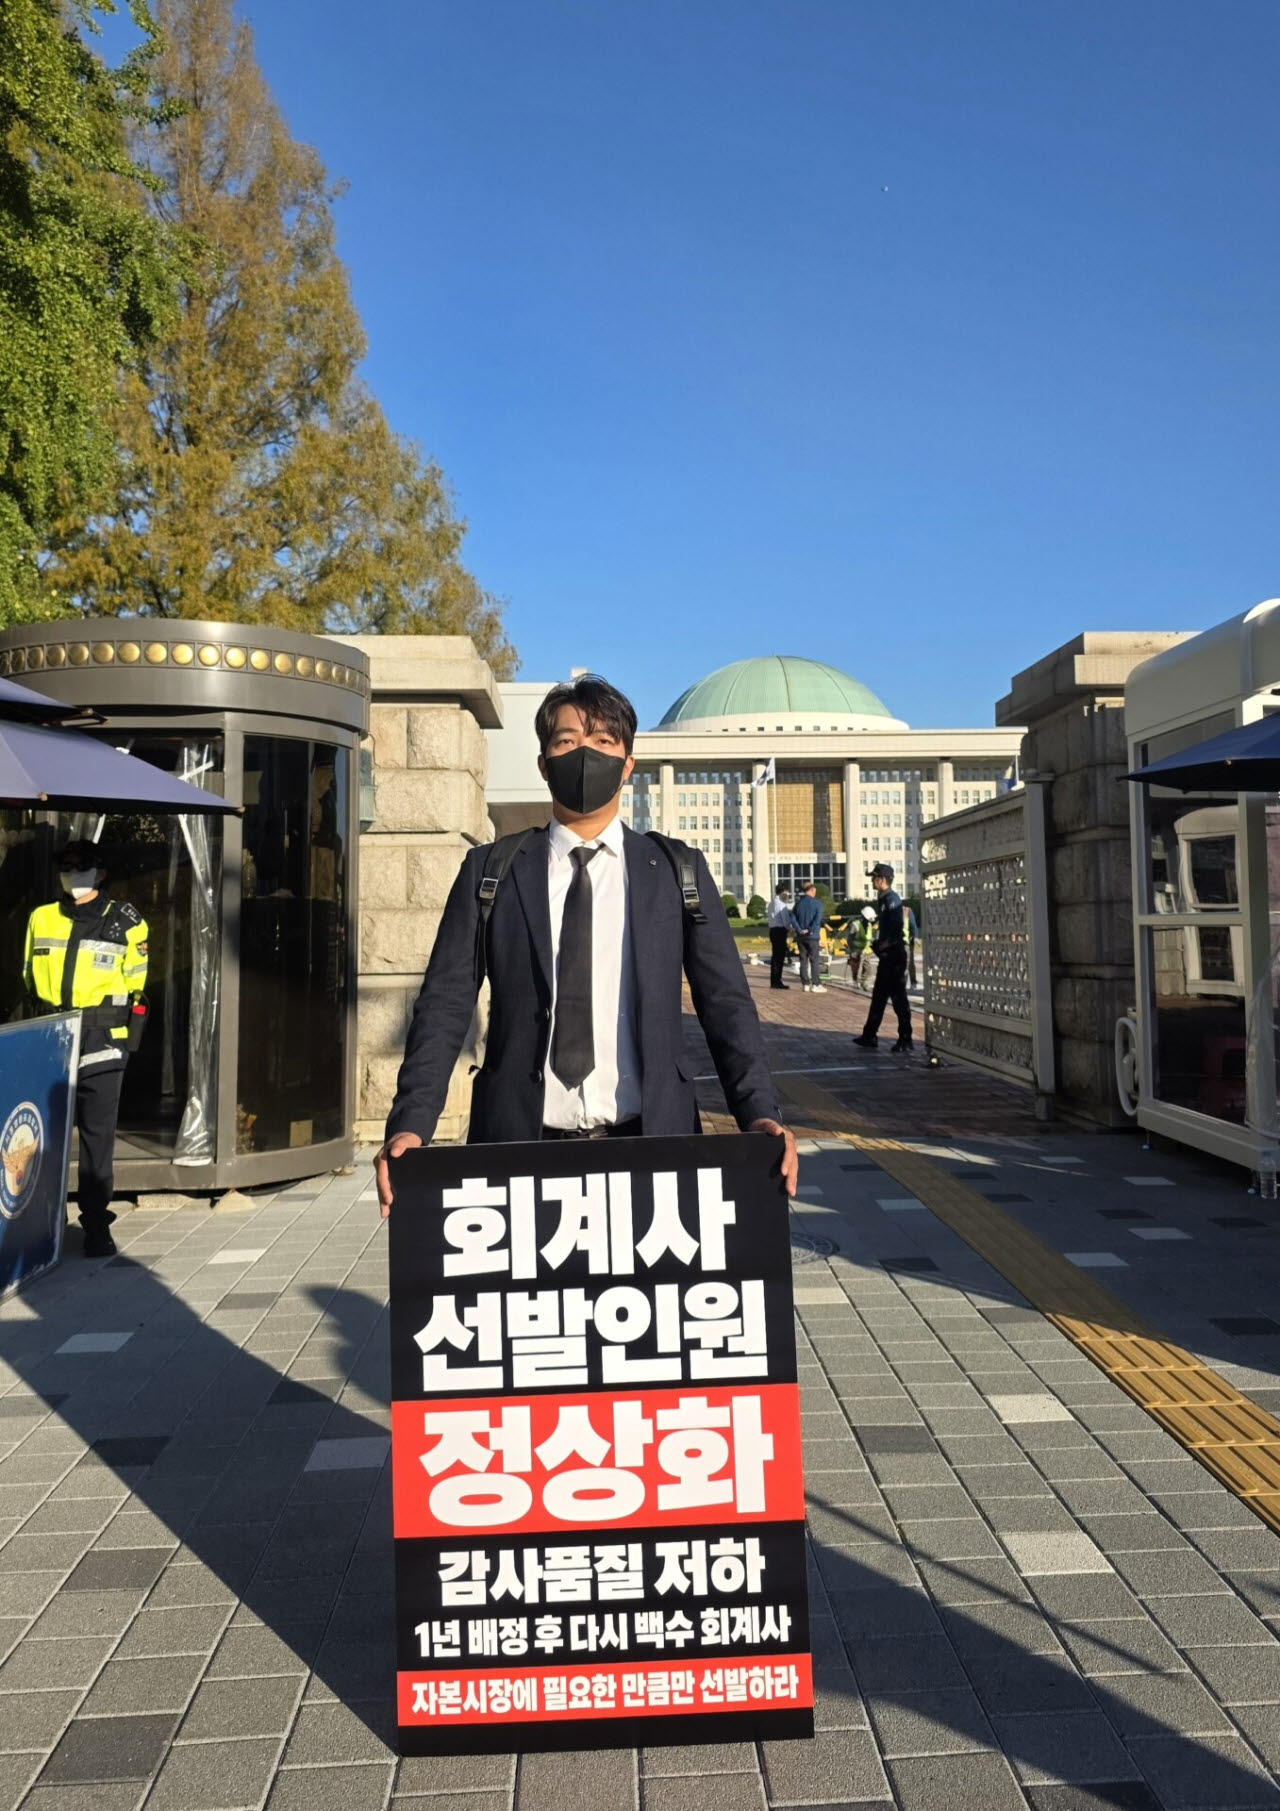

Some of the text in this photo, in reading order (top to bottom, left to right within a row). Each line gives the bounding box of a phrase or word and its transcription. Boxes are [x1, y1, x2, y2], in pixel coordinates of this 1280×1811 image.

[442, 1168, 736, 1280] 회계사
[414, 1280, 768, 1392] 선발인원
[419, 1395, 774, 1527] 정상화
[438, 1538, 766, 1606] 감사품질 저하
[414, 1605, 792, 1658] 1년 배정 후 다시 백수 회계사
[411, 1664, 800, 1716] 자본시장에 필요한 만큼만 선발하라
